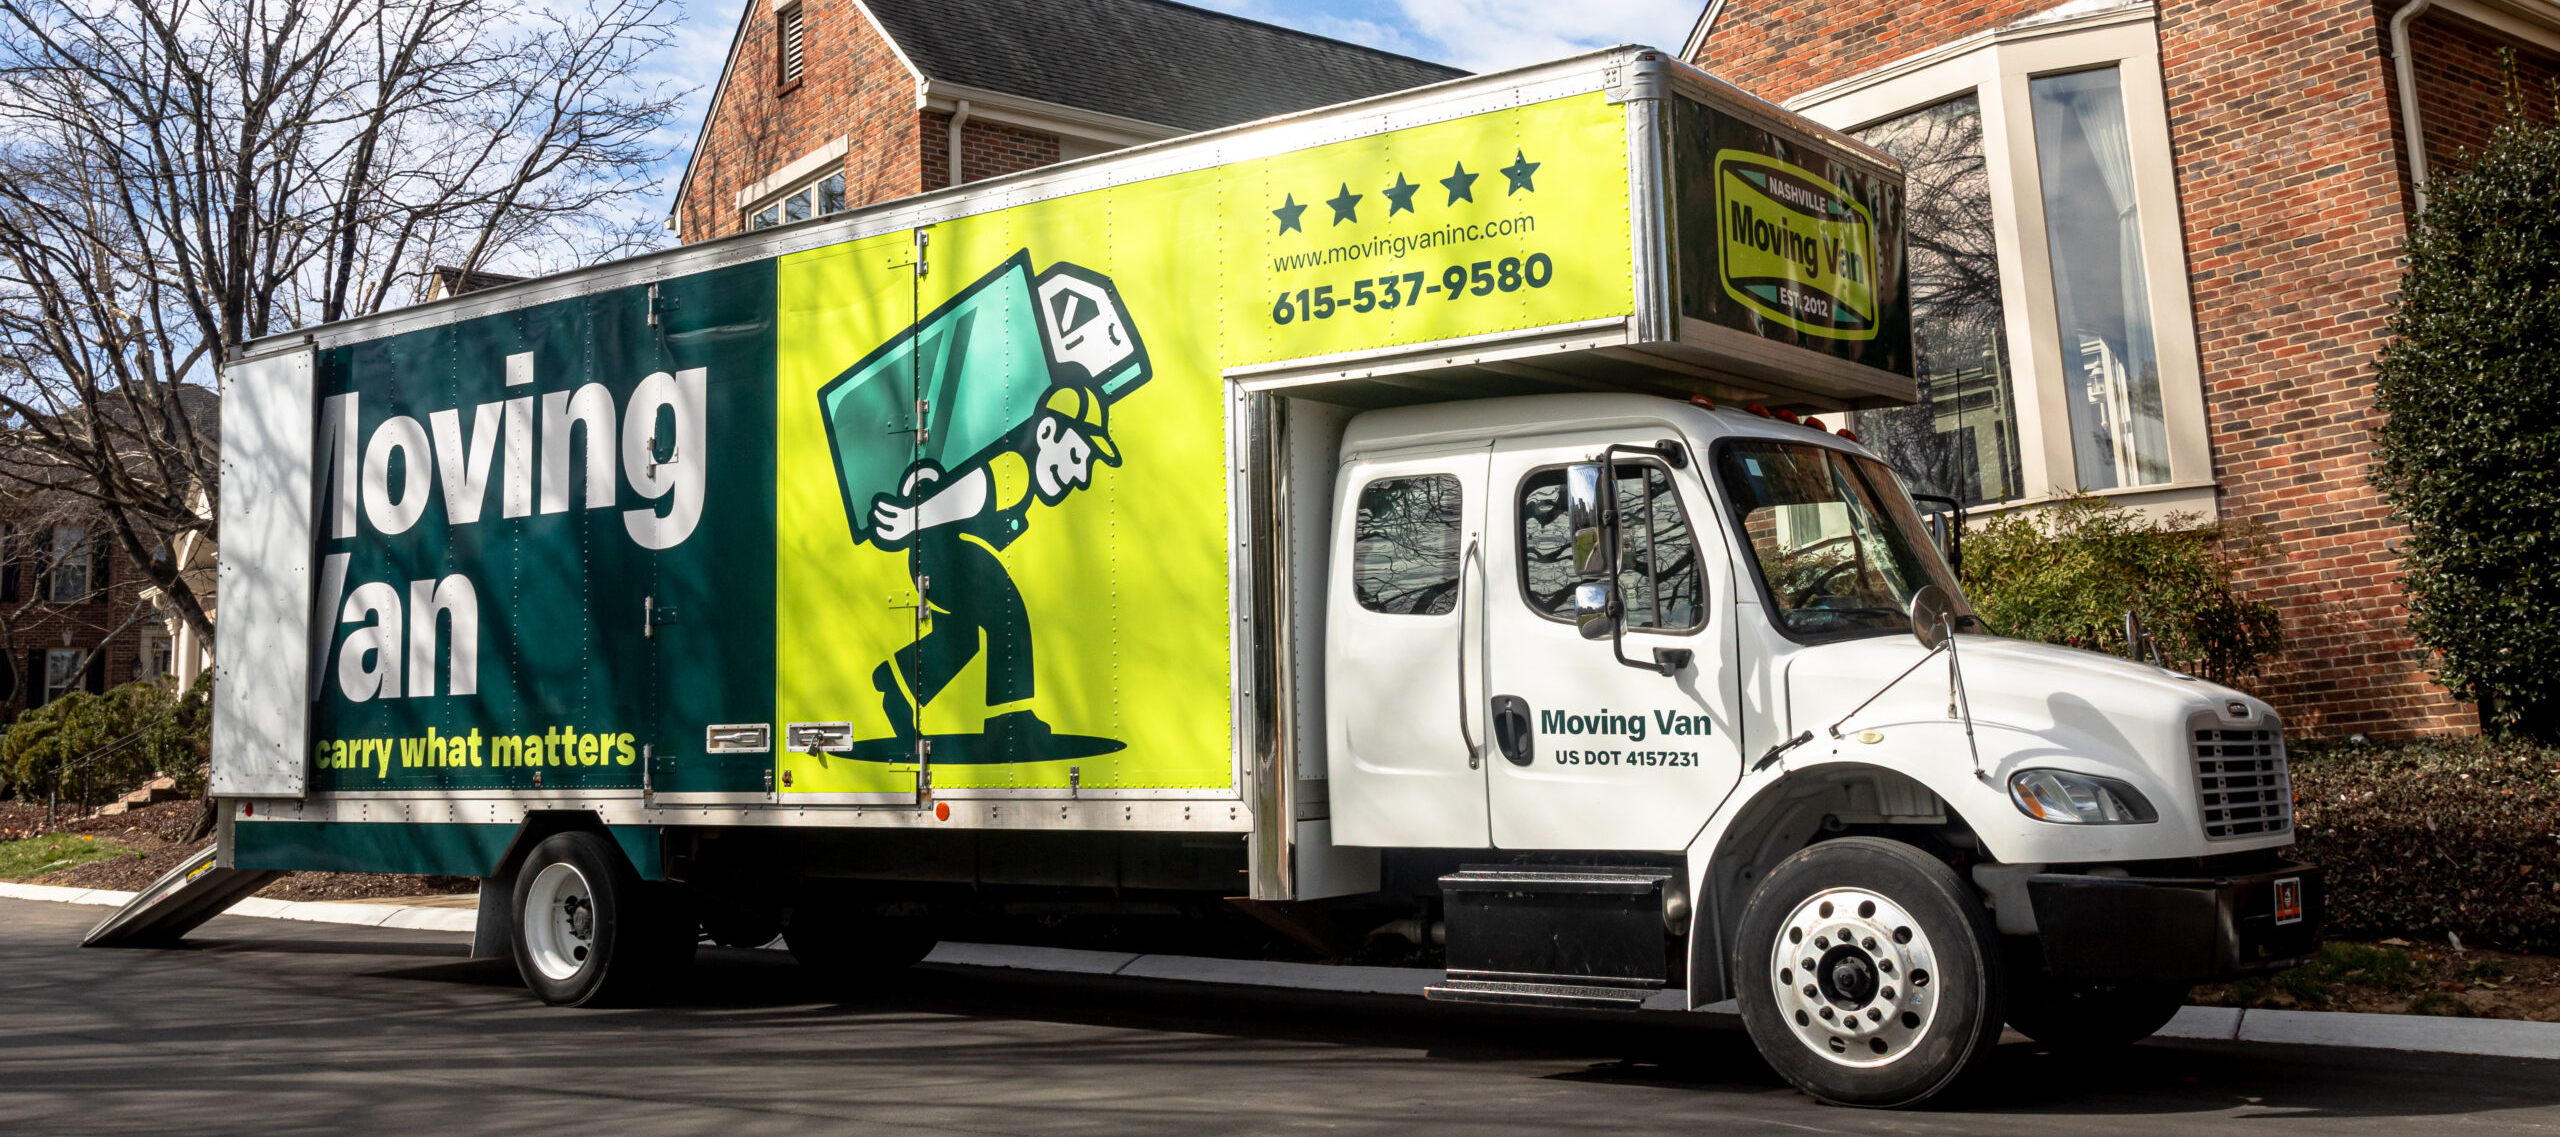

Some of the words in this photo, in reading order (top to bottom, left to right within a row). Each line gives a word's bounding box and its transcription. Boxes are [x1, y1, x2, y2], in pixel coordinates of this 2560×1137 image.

[1769, 176, 1826, 213] NASHVILLE
[1273, 215, 1535, 273] www.movingvaninc.com
[1731, 200, 1819, 279] Moving
[1823, 234, 1864, 284] Van
[1272, 252, 1553, 326] 615-537-9580
[1780, 287, 1802, 309] EST.
[1804, 295, 1829, 318] 2012
[1541, 708, 1646, 742] Moving
[1653, 709, 1712, 736] Van
[314, 738, 393, 779] carry
[400, 726, 483, 768] what
[491, 725, 636, 767] matters
[1555, 750, 1580, 765] US
[1584, 750, 1622, 766] DOT
[1626, 751, 1699, 767] 4157231
